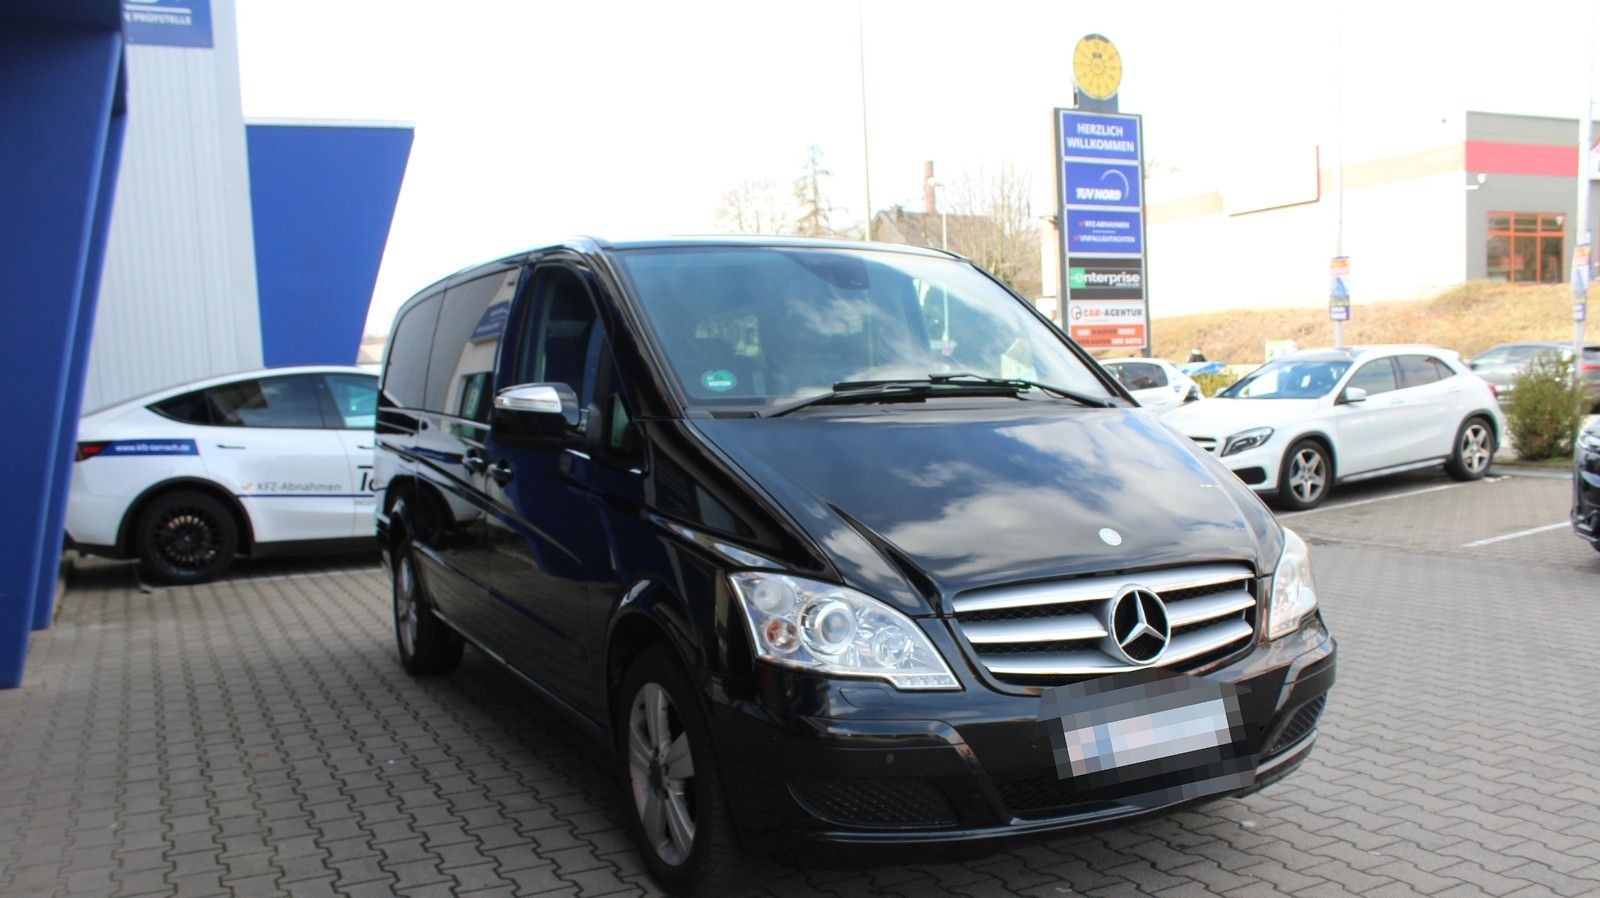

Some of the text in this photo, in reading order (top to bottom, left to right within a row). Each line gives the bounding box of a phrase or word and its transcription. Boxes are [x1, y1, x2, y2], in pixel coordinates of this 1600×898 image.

[1076, 123, 1124, 137] HERZLICH
[1066, 137, 1135, 152] WILLKOMMEN
[1070, 271, 1141, 286] enterprise
[257, 481, 342, 492] KFZ-Abnahmen
